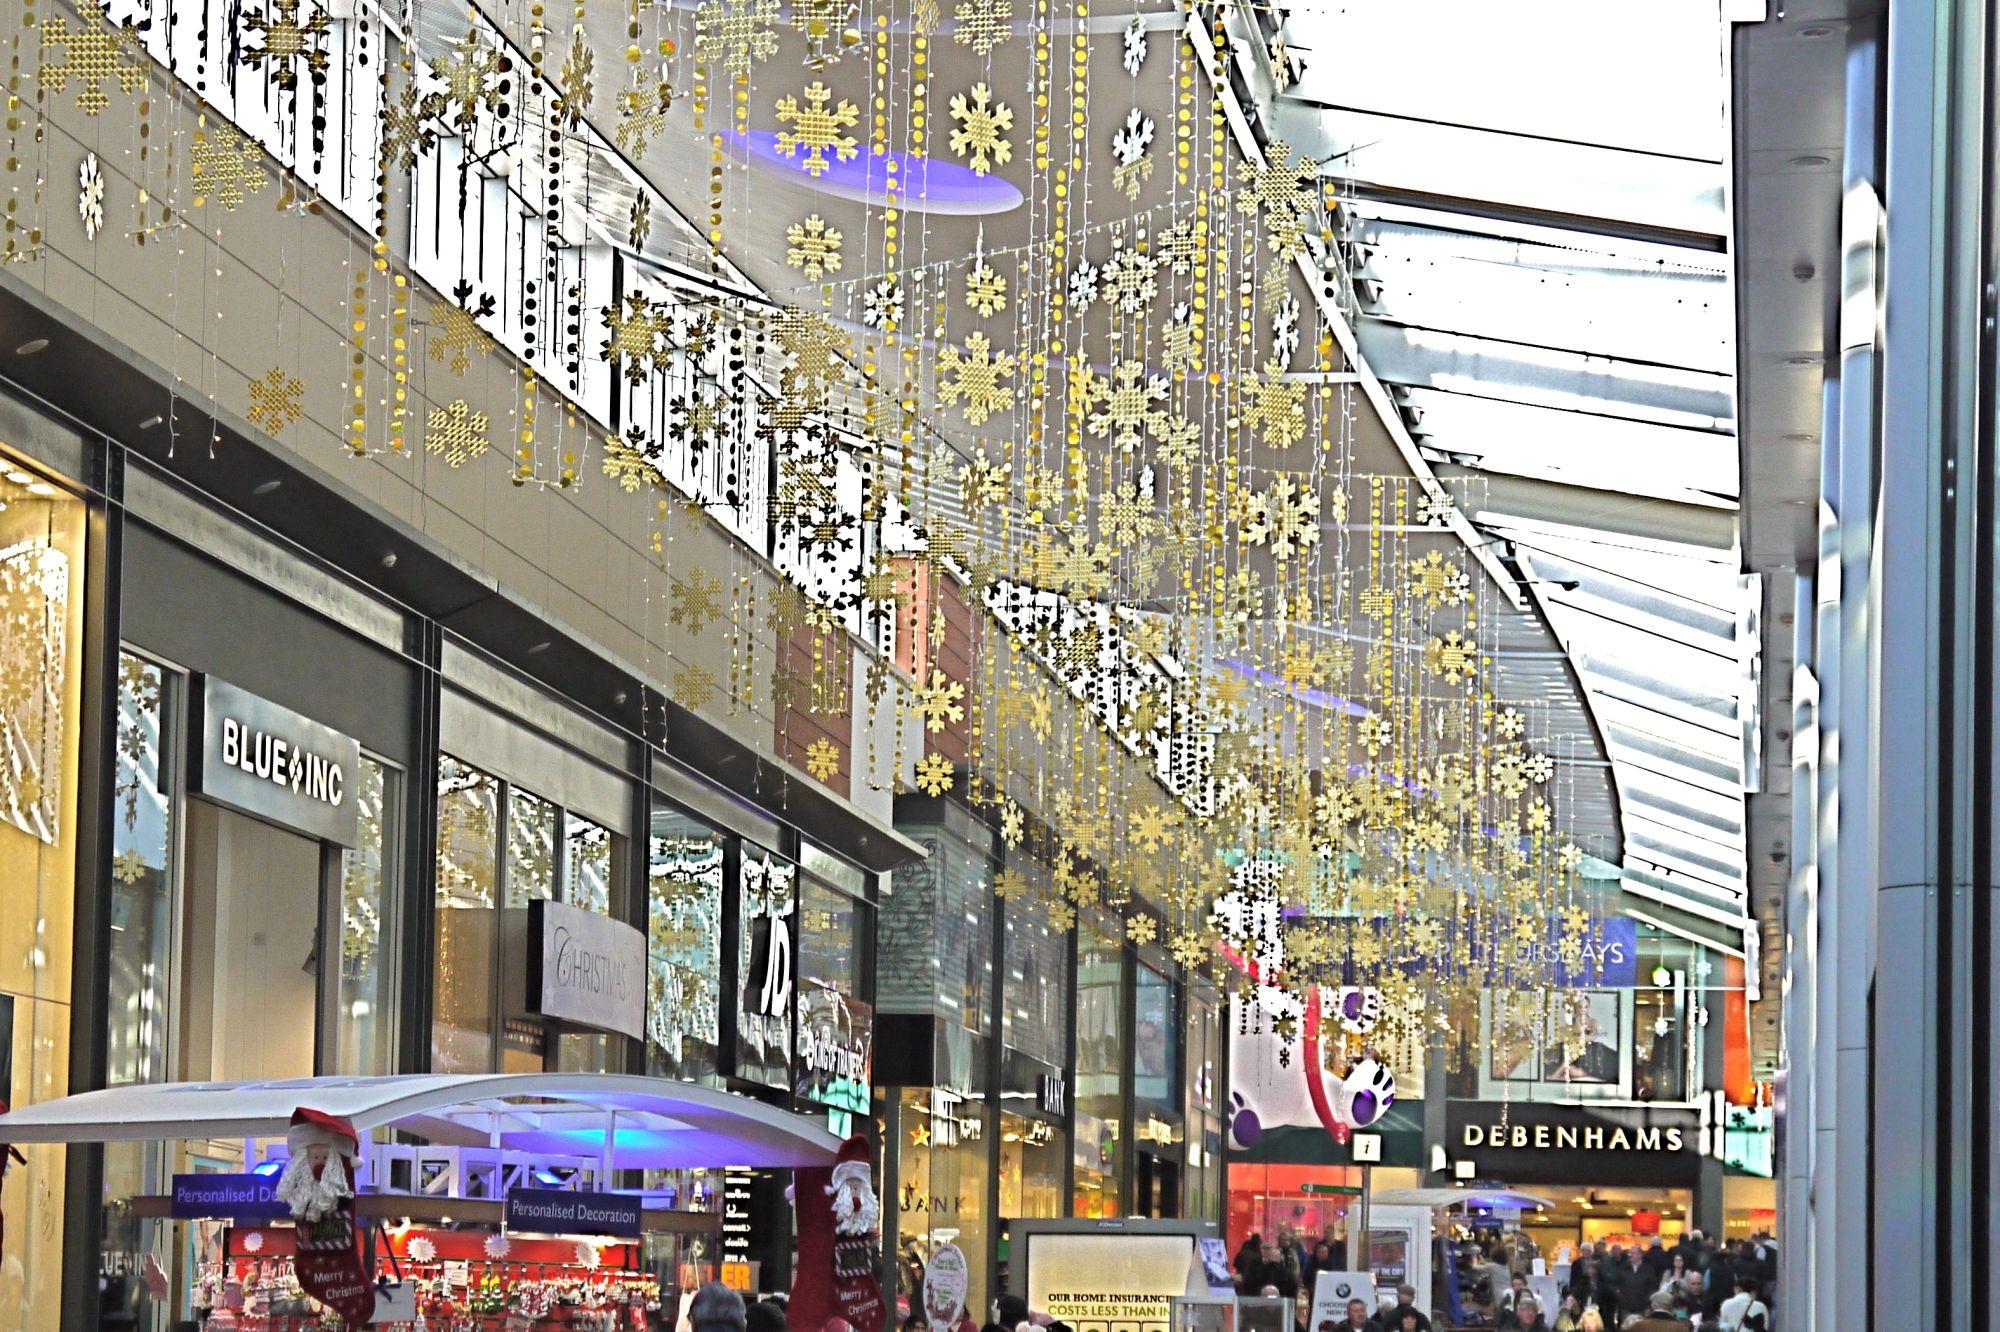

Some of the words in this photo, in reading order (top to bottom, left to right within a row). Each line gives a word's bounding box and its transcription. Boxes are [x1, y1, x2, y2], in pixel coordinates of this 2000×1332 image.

[223, 717, 287, 786] BLUE
[305, 752, 343, 807] INC
[760, 916, 790, 1017] JD
[1045, 1074, 1065, 1117] BANK
[1464, 1125, 1683, 1151] DEBENHAMS
[177, 1187, 254, 1203] Personalised
[512, 1200, 575, 1219] Personalised
[577, 1204, 636, 1223] Decoration
[314, 1271, 344, 1284] Merry
[840, 1290, 862, 1301] Merry
[1048, 1293, 1071, 1302] OUR
[1073, 1294, 1107, 1302] HOME
[1048, 1305, 1088, 1316] COSTS
[1091, 1306, 1119, 1316] LESS
[1122, 1306, 1156, 1316] THAN
